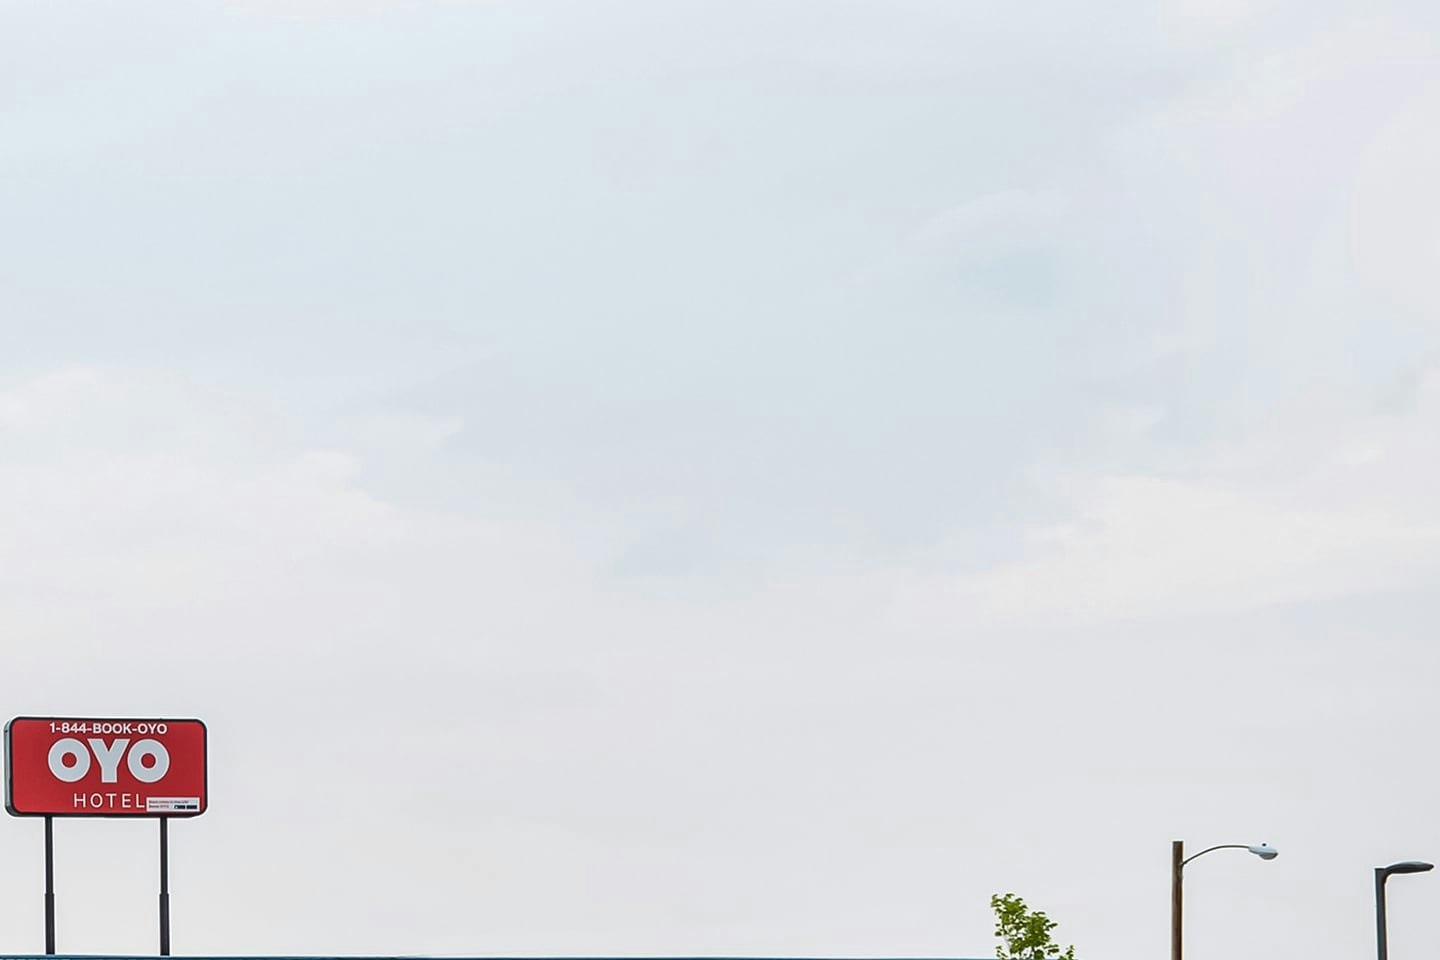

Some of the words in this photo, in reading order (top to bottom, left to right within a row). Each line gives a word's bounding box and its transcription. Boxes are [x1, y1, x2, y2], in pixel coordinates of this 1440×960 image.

[49, 722, 168, 735] 1-844-BOOK-OYO
[47, 737, 170, 783] OYO
[73, 793, 145, 809] HOTEL
